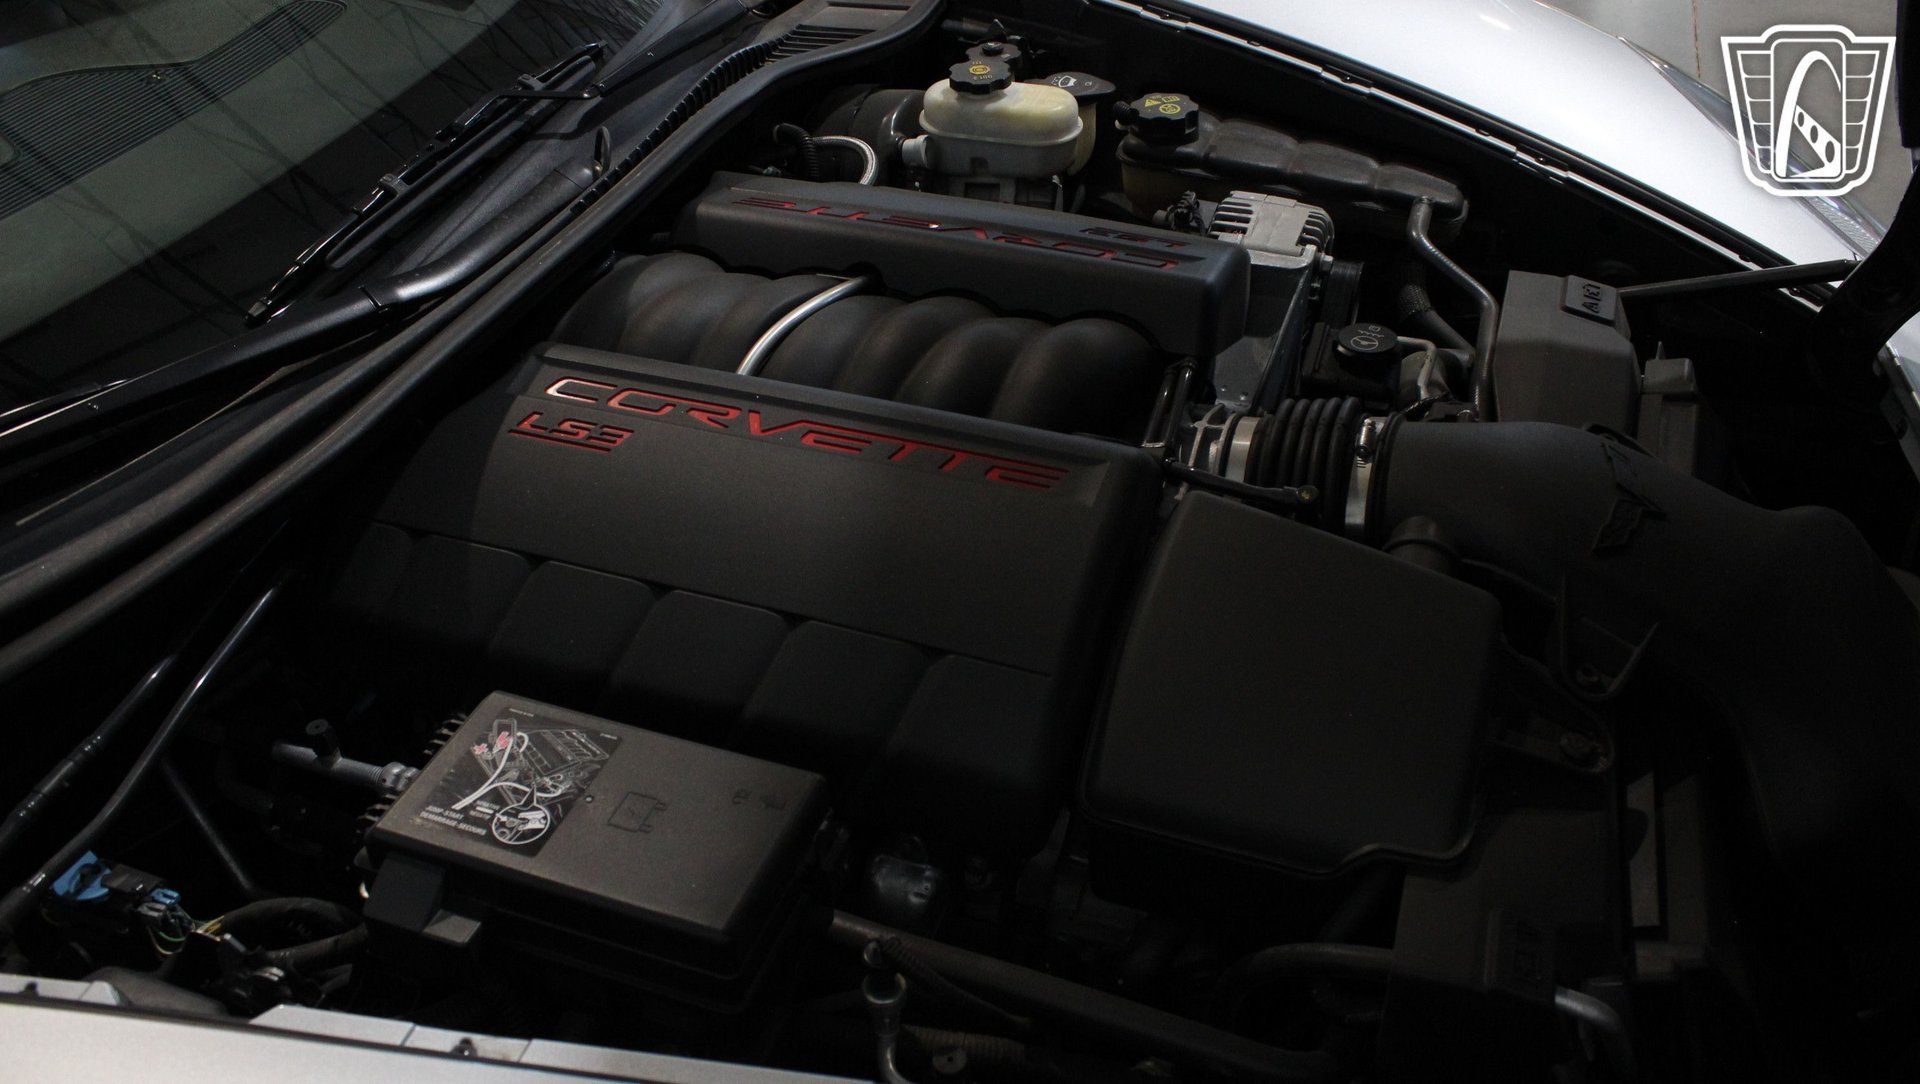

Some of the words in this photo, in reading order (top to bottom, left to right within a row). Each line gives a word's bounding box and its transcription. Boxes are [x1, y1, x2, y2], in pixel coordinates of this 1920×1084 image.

[732, 197, 1180, 269] CORVETTE
[509, 411, 634, 451] LS3
[544, 375, 1070, 489] CORVETTE
